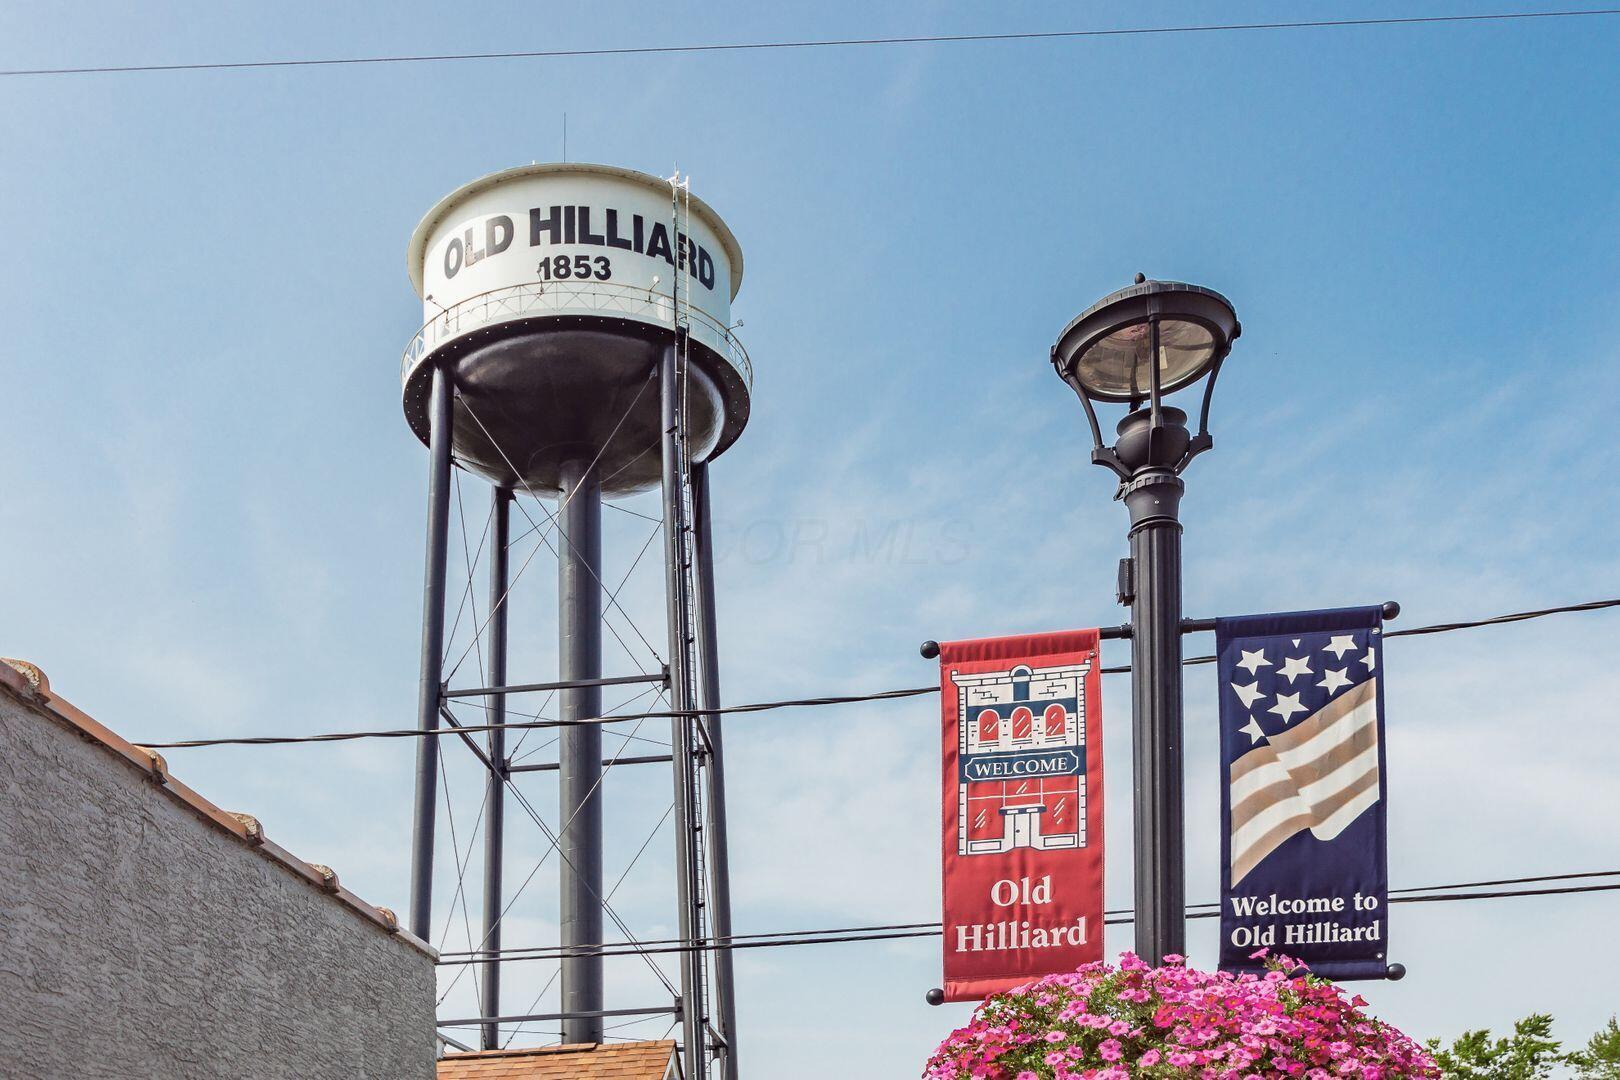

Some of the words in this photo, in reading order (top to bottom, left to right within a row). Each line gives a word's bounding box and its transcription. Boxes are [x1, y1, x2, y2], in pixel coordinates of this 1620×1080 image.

[444, 214, 514, 280] OLD
[529, 205, 715, 291] HILLIARD
[540, 255, 612, 281] 1853
[974, 756, 1069, 777] WELCOME
[990, 874, 1053, 907] Old
[1230, 893, 1345, 917] Welcome
[1353, 891, 1379, 911] to
[955, 915, 1088, 953] Hilliard
[1230, 924, 1276, 948] Old
[1284, 919, 1381, 946] Hilliard
